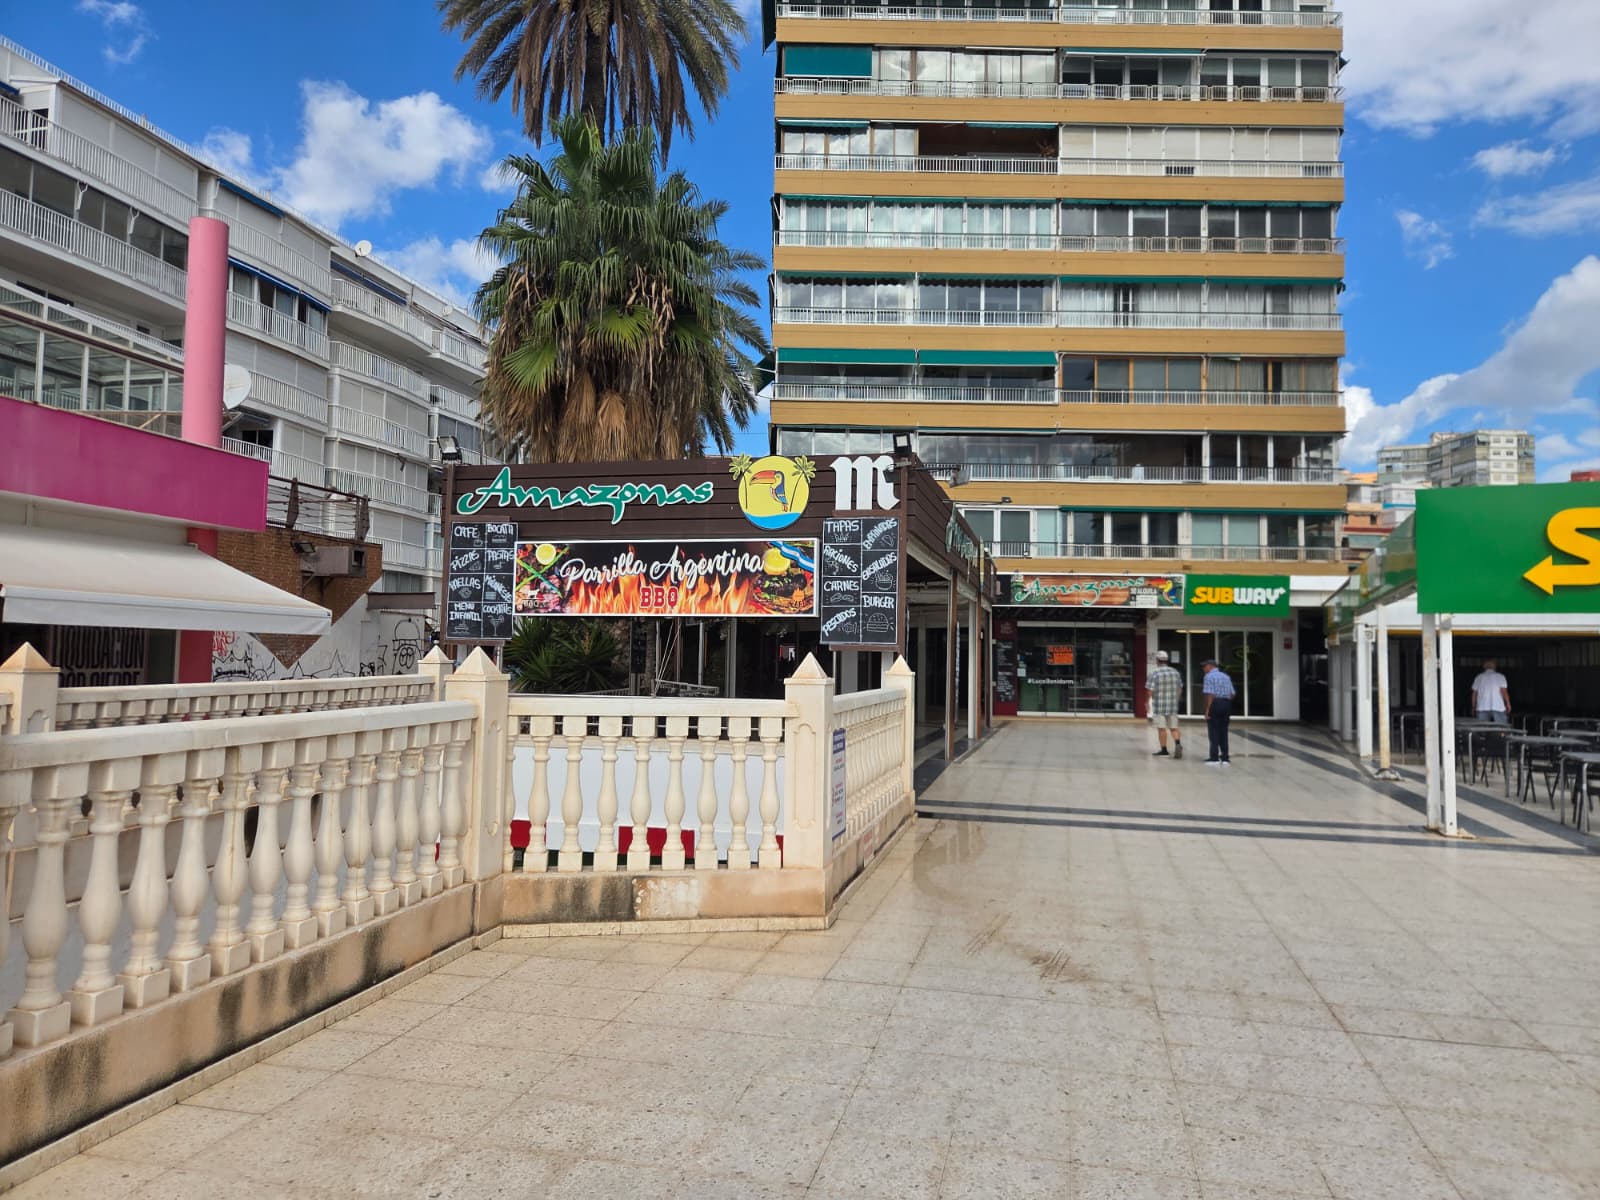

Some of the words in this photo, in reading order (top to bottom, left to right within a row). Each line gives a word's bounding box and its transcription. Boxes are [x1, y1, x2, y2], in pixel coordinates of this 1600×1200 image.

[457, 466, 714, 525] Amazonas
[823, 520, 860, 534] TAPAS
[560, 552, 647, 600] Parrilla
[649, 544, 765, 590] Argentina
[823, 580, 860, 592] CARNES
[1014, 577, 1145, 606] Amazonas
[1191, 586, 1287, 605] SUBWAY
[640, 586, 679, 609] BBQ
[862, 594, 895, 609] BURGER
